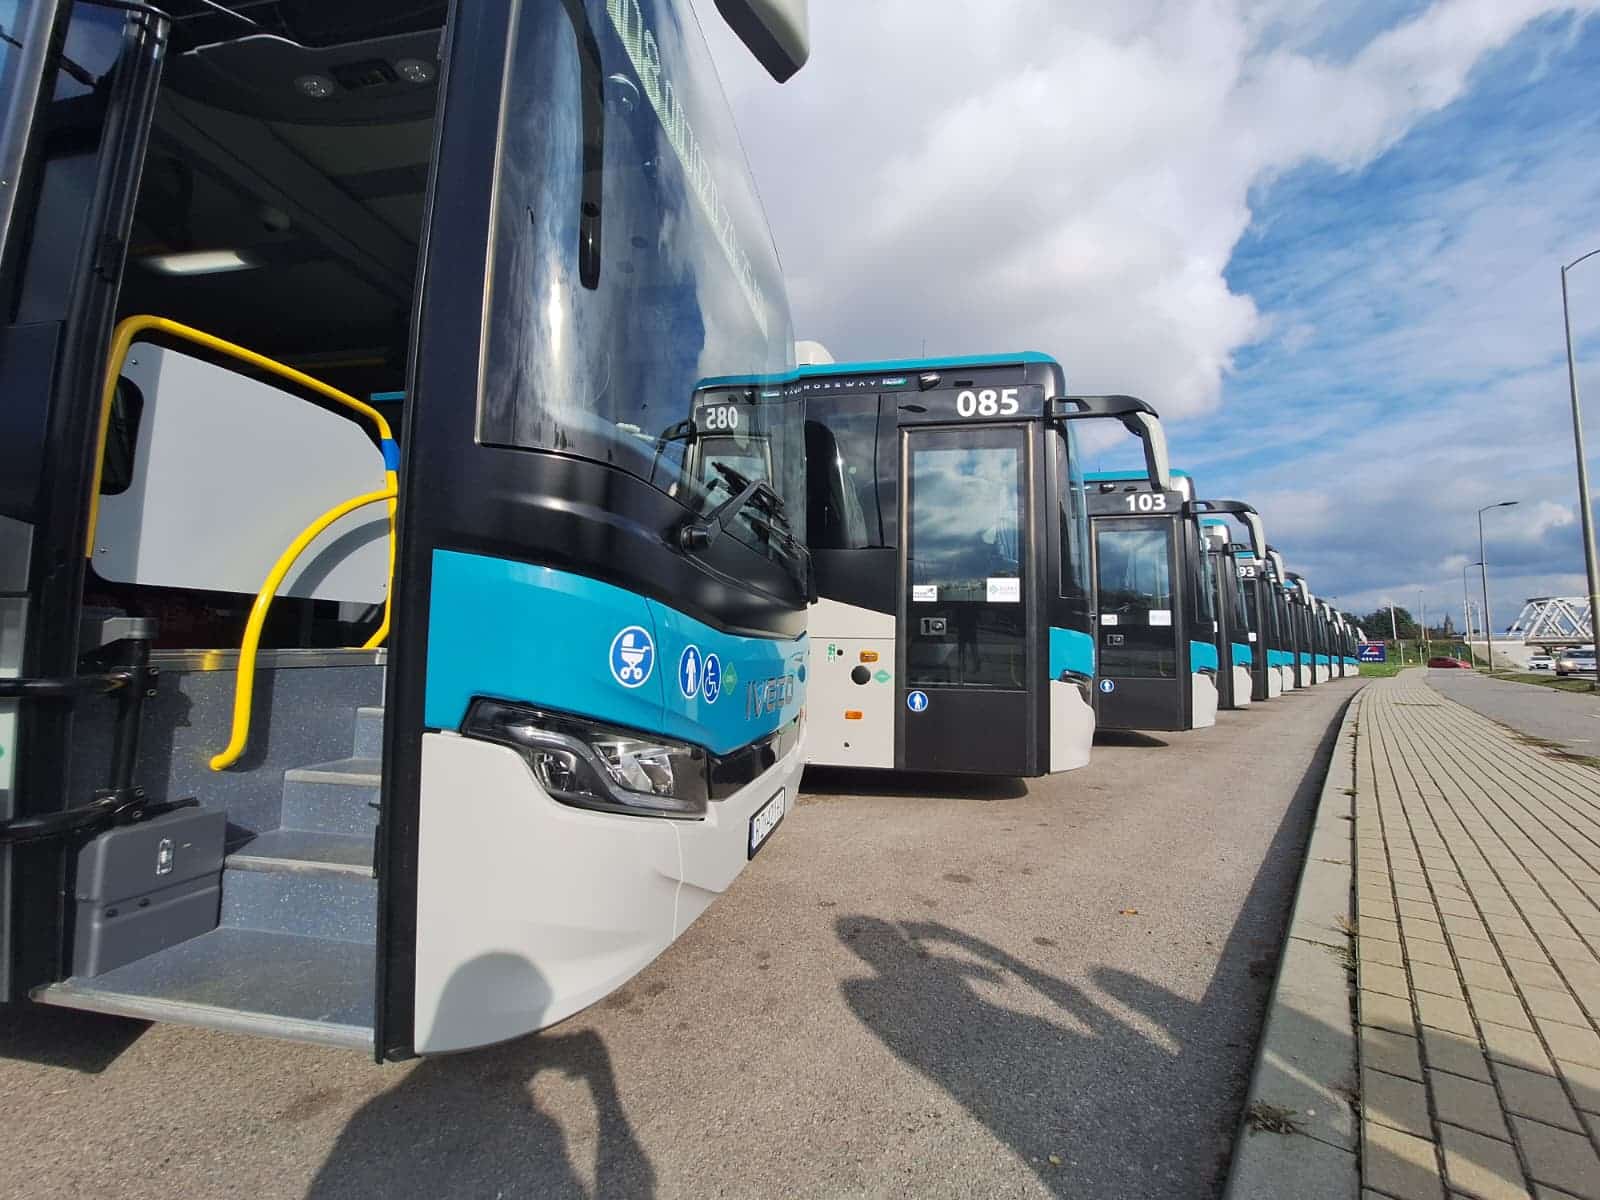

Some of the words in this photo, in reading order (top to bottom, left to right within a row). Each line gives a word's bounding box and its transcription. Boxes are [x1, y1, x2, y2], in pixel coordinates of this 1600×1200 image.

[803, 380, 877, 391] ROSSWAY
[957, 388, 1019, 417] 085
[1125, 493, 1167, 512] 103
[1238, 566, 1255, 577] 93
[744, 674, 794, 721] IVECO
